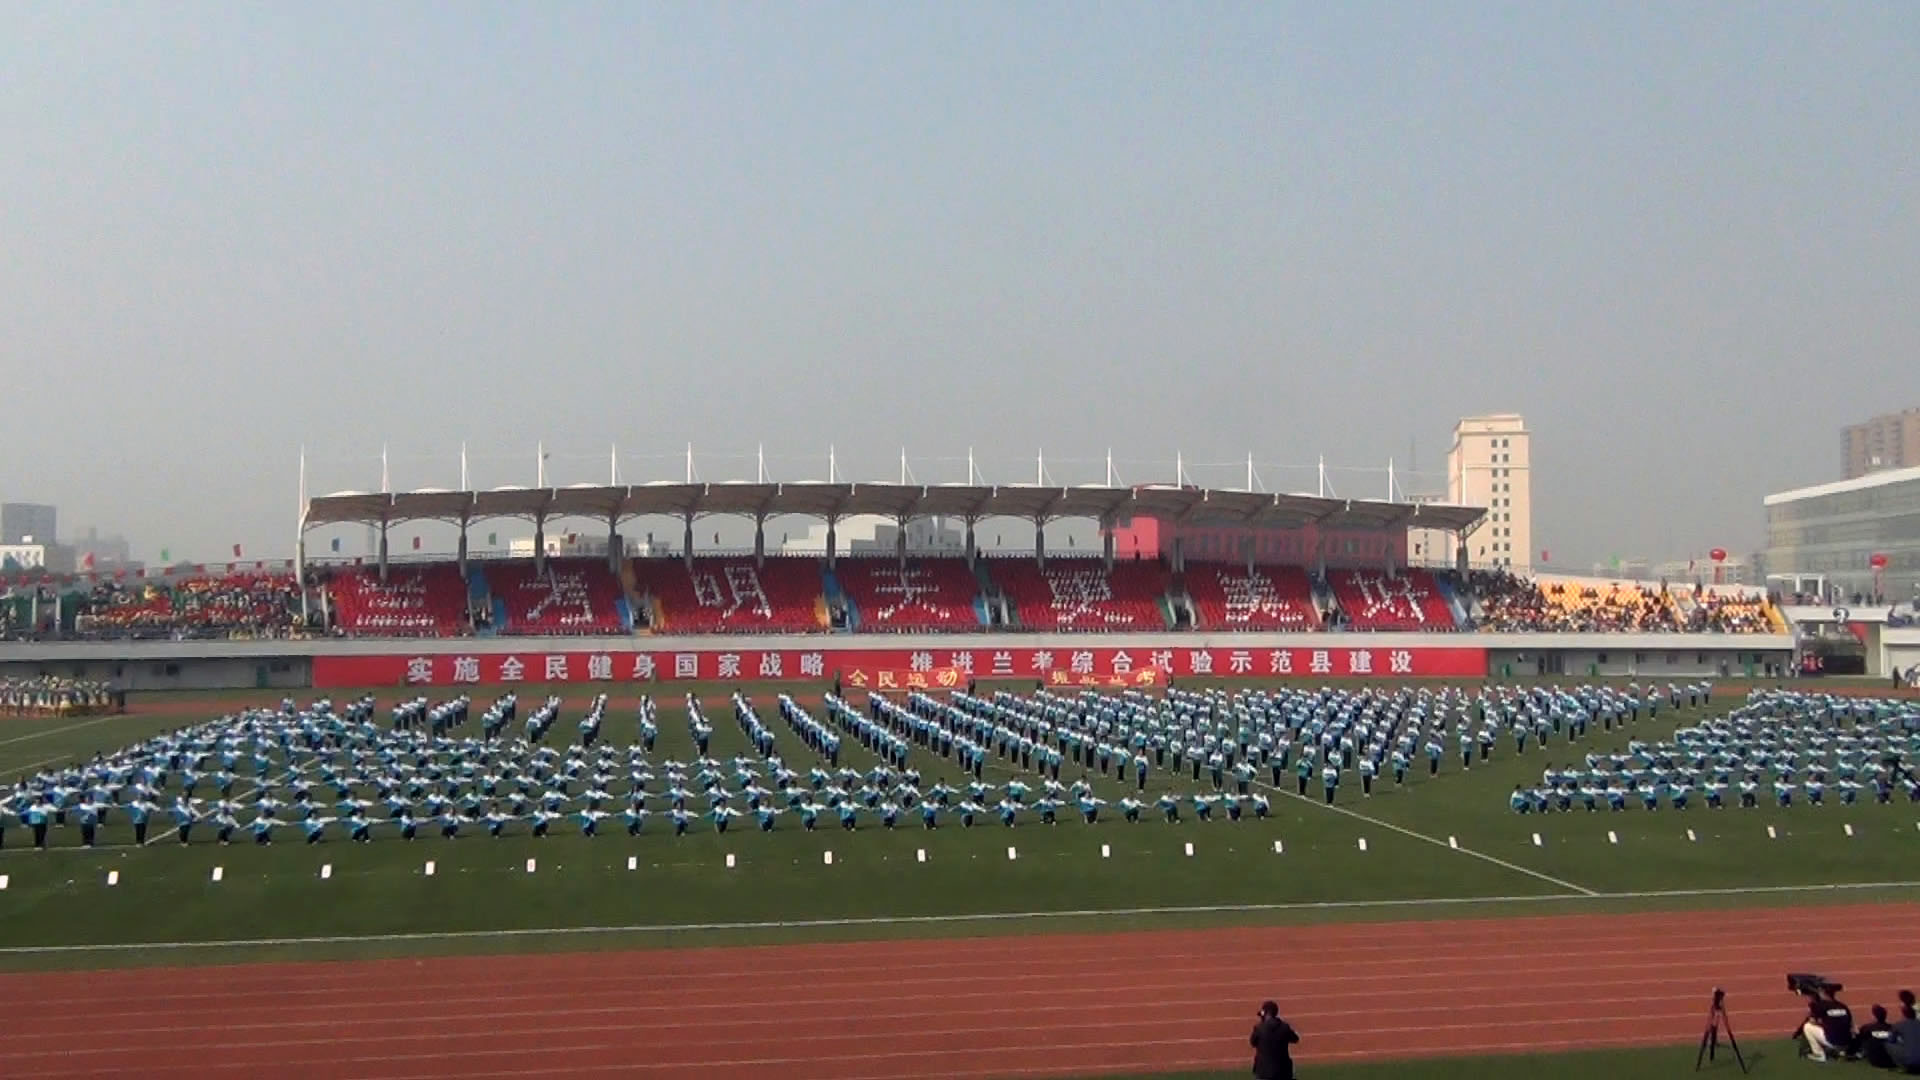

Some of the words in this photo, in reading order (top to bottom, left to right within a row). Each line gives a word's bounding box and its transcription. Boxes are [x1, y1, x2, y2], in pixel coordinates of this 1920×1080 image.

[407, 653, 825, 682] 实施全民健身国家战略
[910, 650, 1413, 675] 推进兰考综合试验示范县建设
